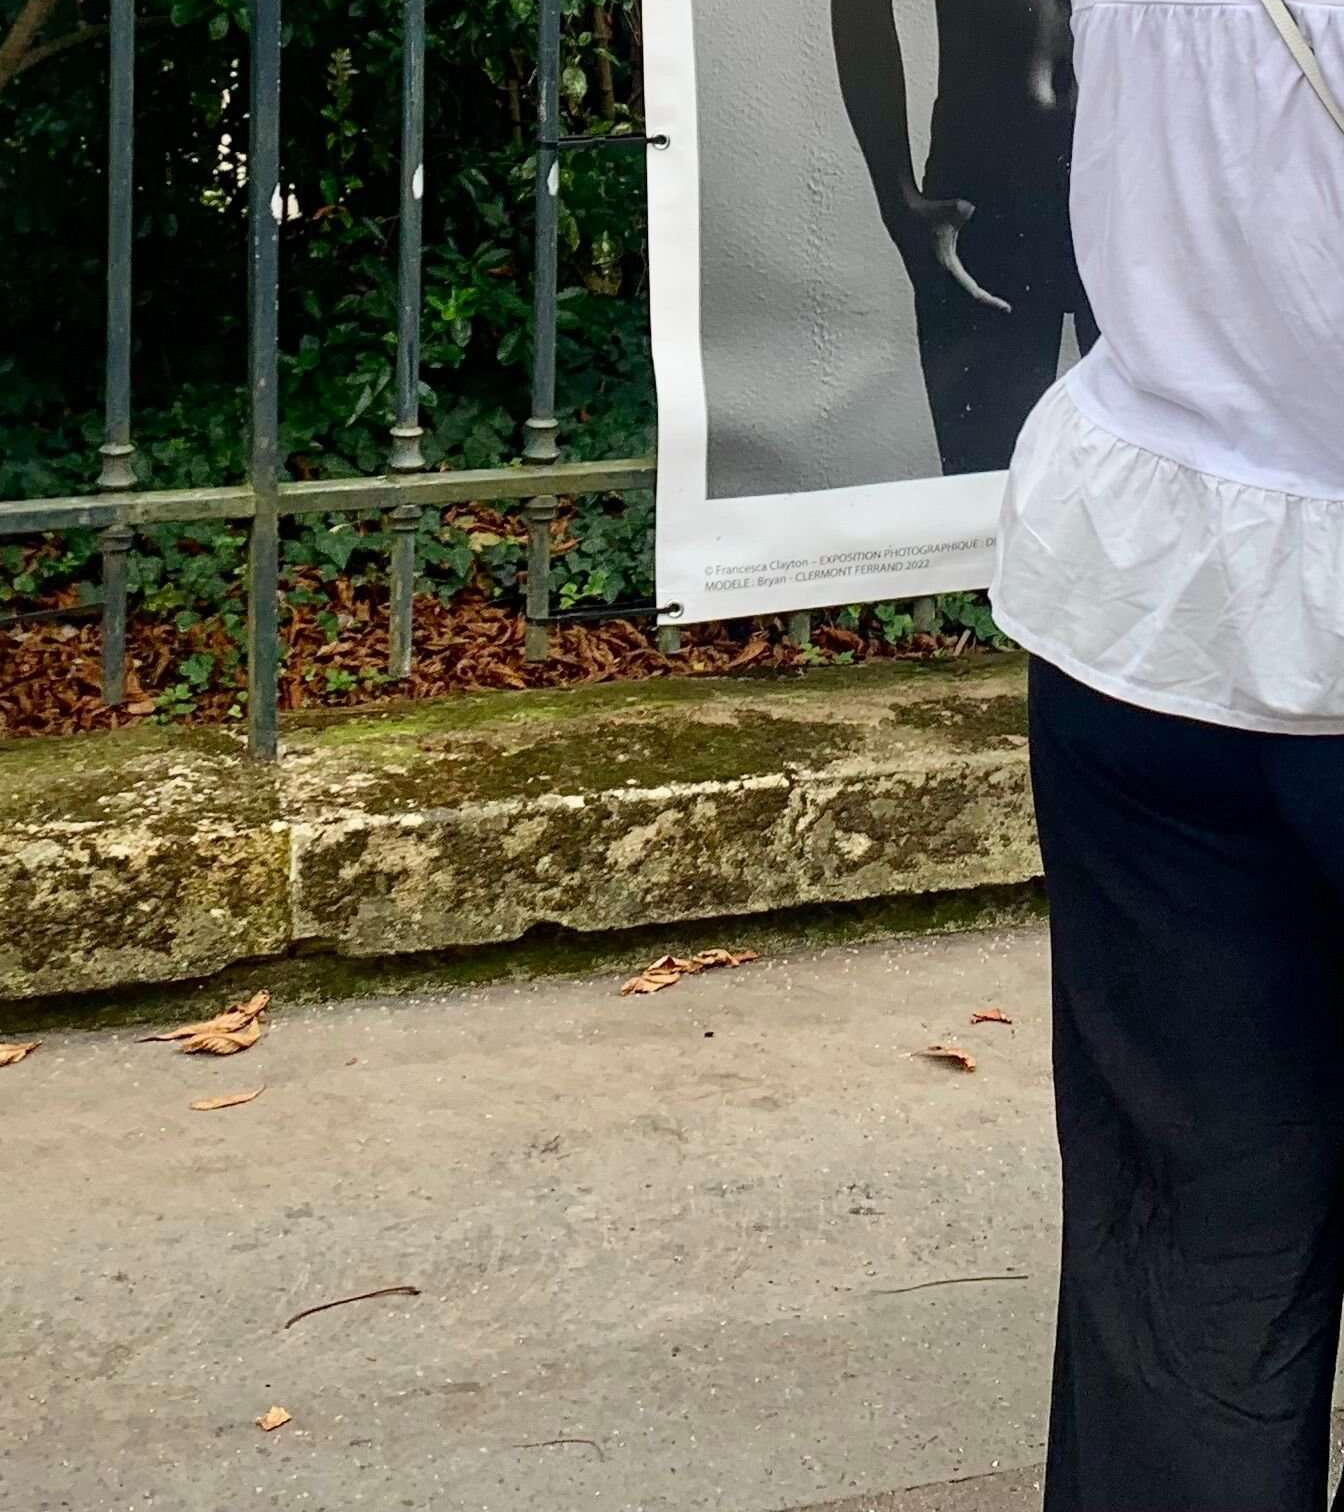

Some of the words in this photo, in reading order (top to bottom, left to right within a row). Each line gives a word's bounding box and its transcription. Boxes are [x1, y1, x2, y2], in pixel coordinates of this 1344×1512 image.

[715, 563, 767, 576] Francesca
[769, 559, 809, 571] Clayton
[819, 550, 882, 566] EXPOSITION
[884, 539, 978, 559] PHOTOGRAPHIQUE
[985, 537, 997, 548] DI
[705, 577, 750, 592] MODELE
[757, 575, 787, 588] Bryan
[795, 566, 852, 583] CLERMONT
[854, 561, 904, 575] FERRAND
[905, 559, 930, 571] 2022
